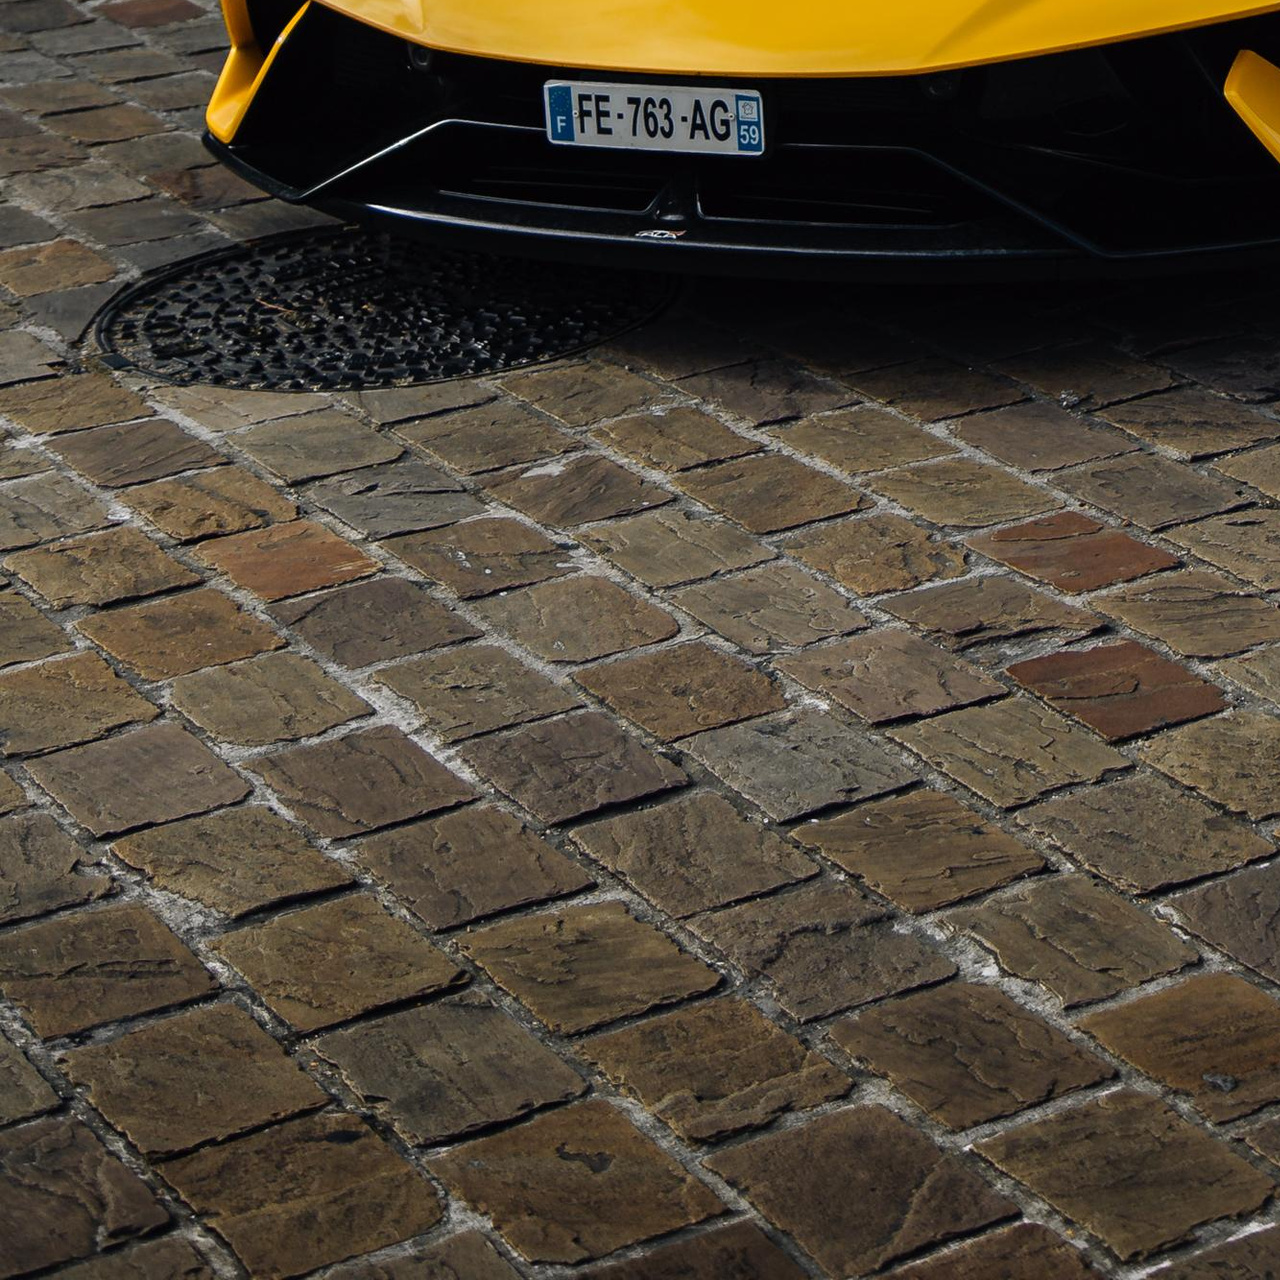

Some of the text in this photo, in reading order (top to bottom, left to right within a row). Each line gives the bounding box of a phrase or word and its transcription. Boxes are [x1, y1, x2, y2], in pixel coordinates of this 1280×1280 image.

[556, 116, 567, 133] F
[577, 93, 731, 142] FE-763-AG
[740, 125, 760, 145] 59
